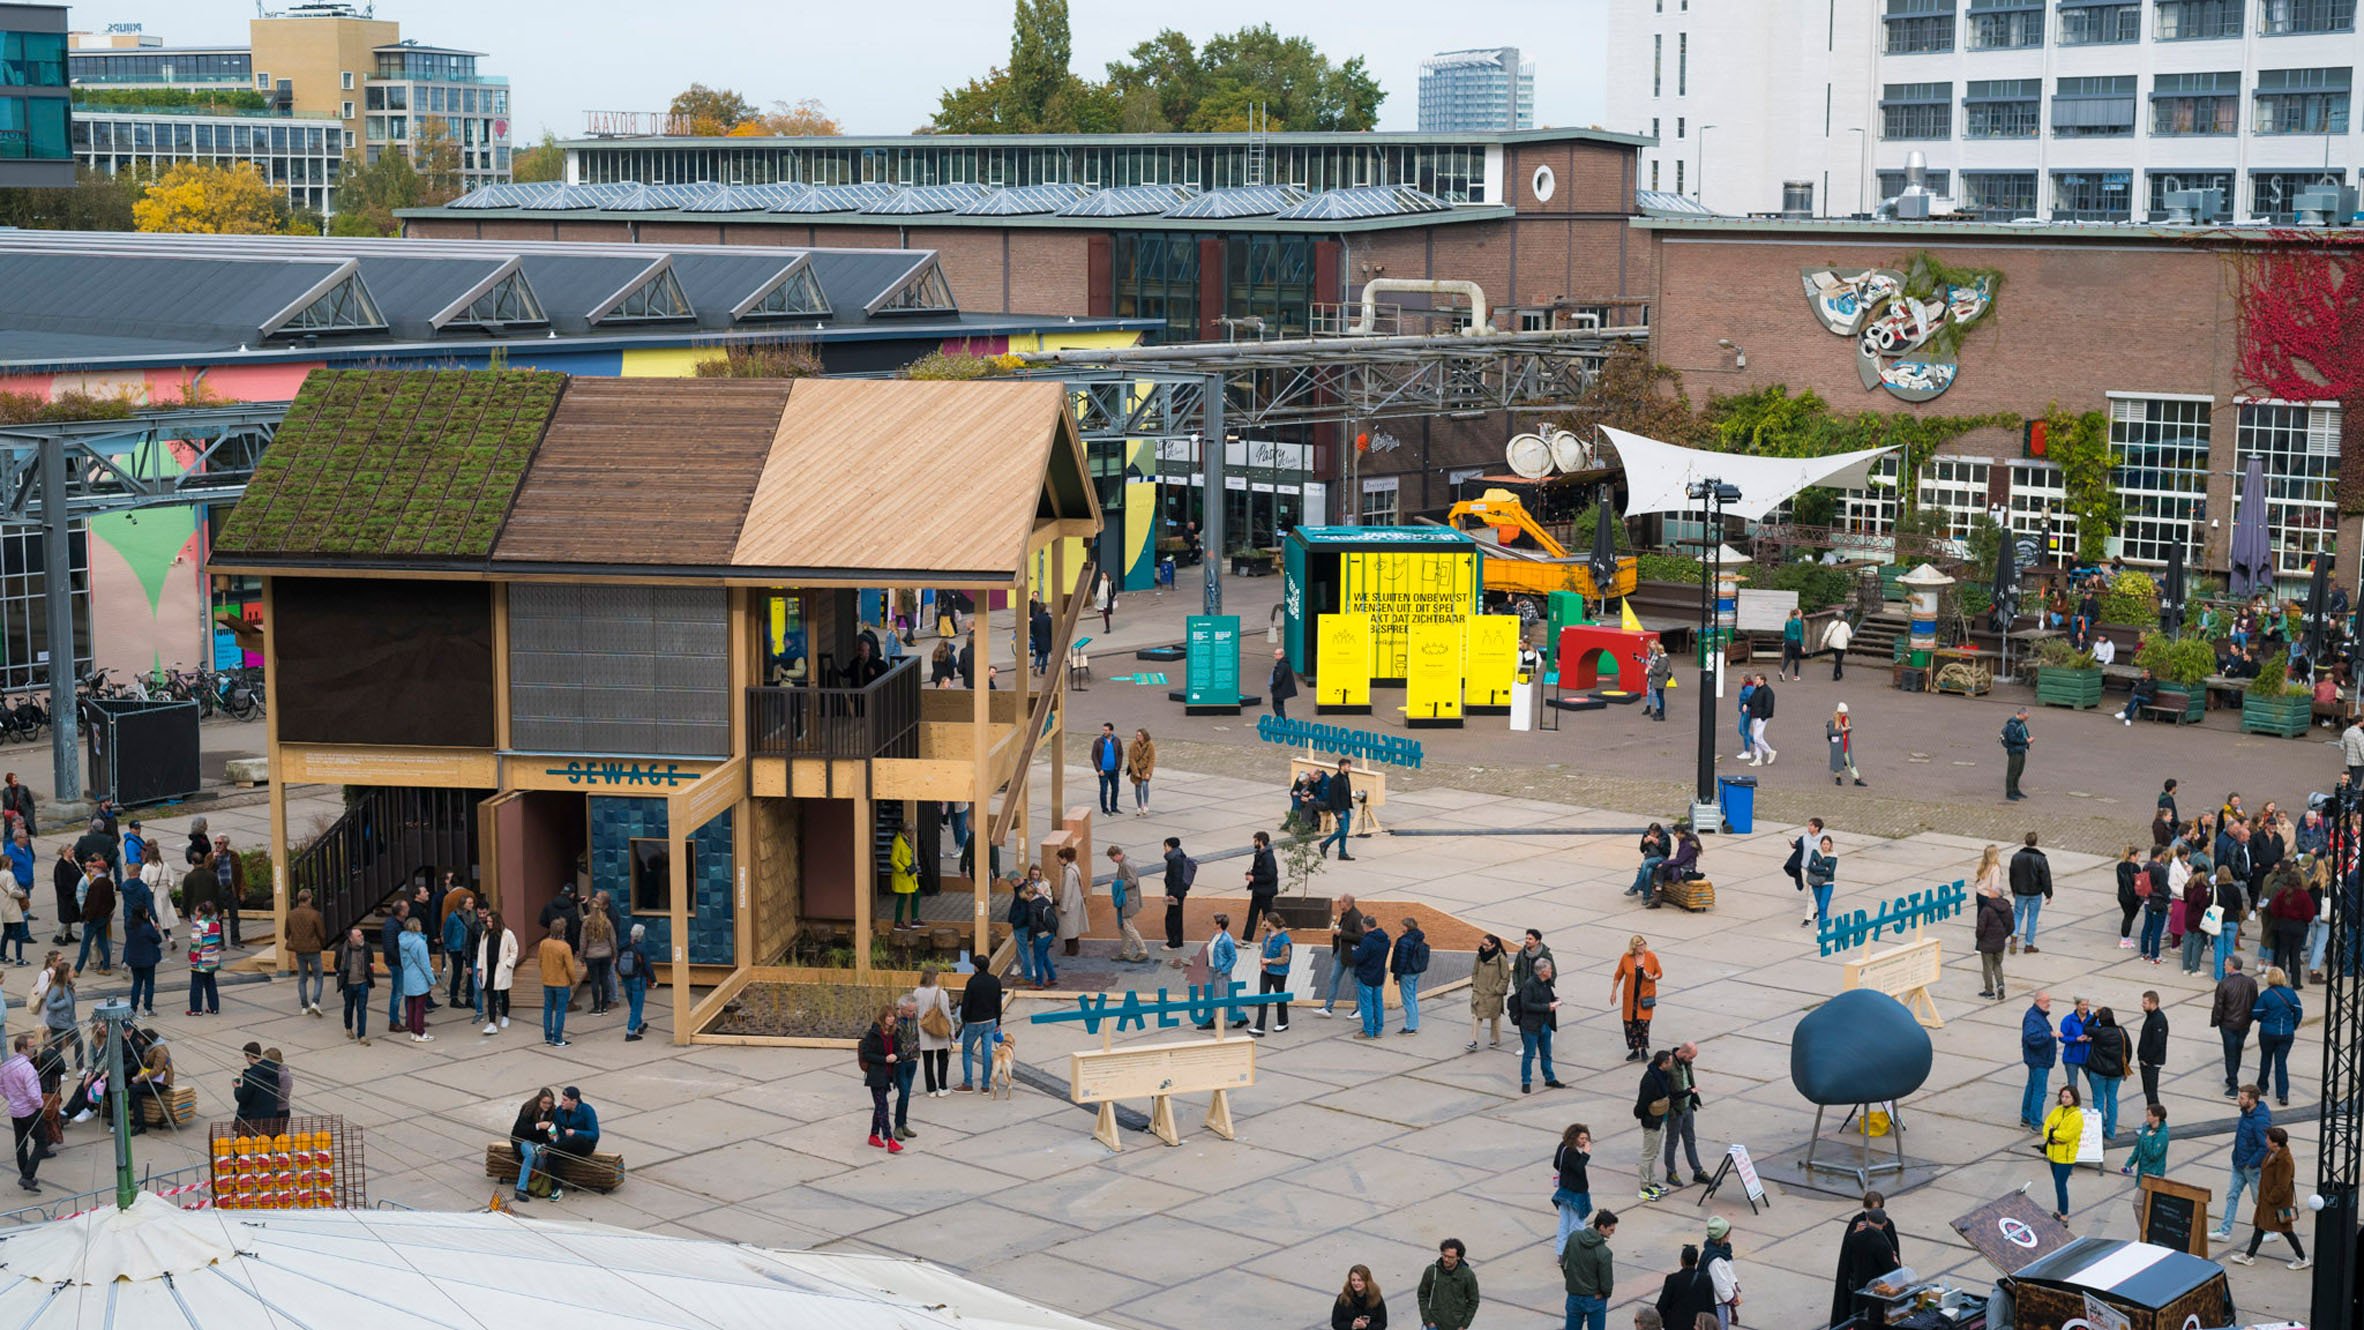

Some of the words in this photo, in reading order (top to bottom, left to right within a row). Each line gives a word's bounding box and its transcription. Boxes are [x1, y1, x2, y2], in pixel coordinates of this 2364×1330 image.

[1354, 593, 1369, 602] WE
[1372, 593, 1410, 602] SLUITEN
[1413, 593, 1468, 602] ONBEWUST
[1354, 604, 1394, 613] MENSEN
[1416, 604, 1430, 613] DIT
[1370, 614, 1389, 623] AKT
[1412, 614, 1466, 624] ZICHTBAAR
[567, 762, 678, 786] SEWAGE
[1893, 879, 1966, 934] START
[1078, 981, 1247, 1035] VALUE
